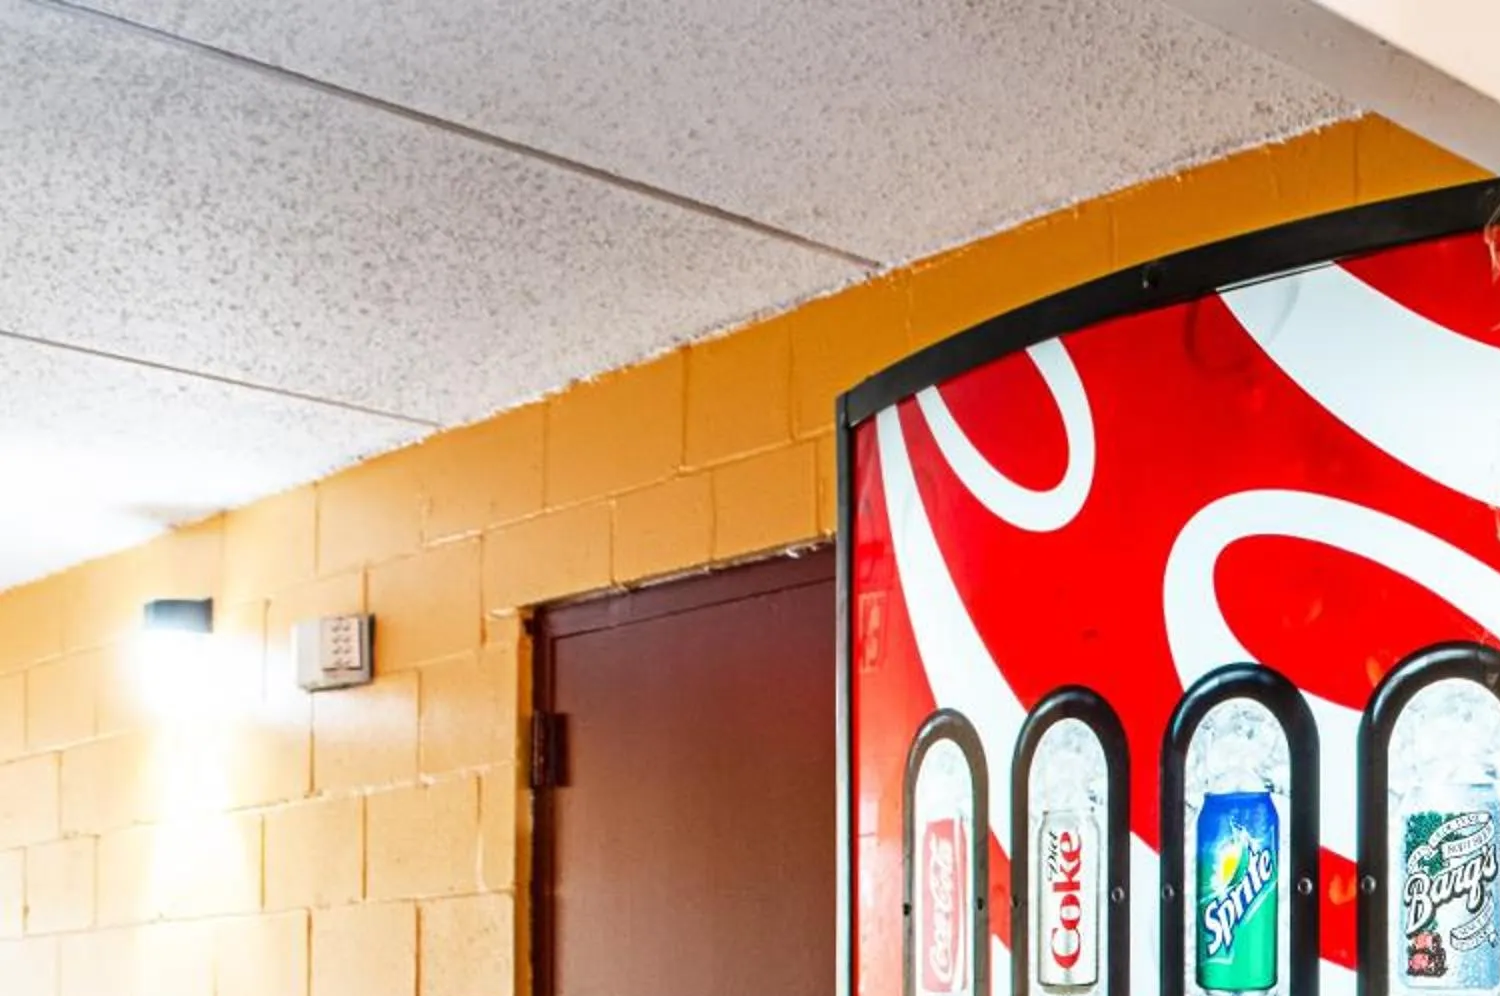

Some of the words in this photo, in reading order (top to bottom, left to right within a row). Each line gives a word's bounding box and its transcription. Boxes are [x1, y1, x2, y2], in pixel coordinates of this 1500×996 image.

[1051, 826, 1082, 969] Coke
[1205, 847, 1273, 956] Sprite
[1404, 843, 1499, 938] Barq's
